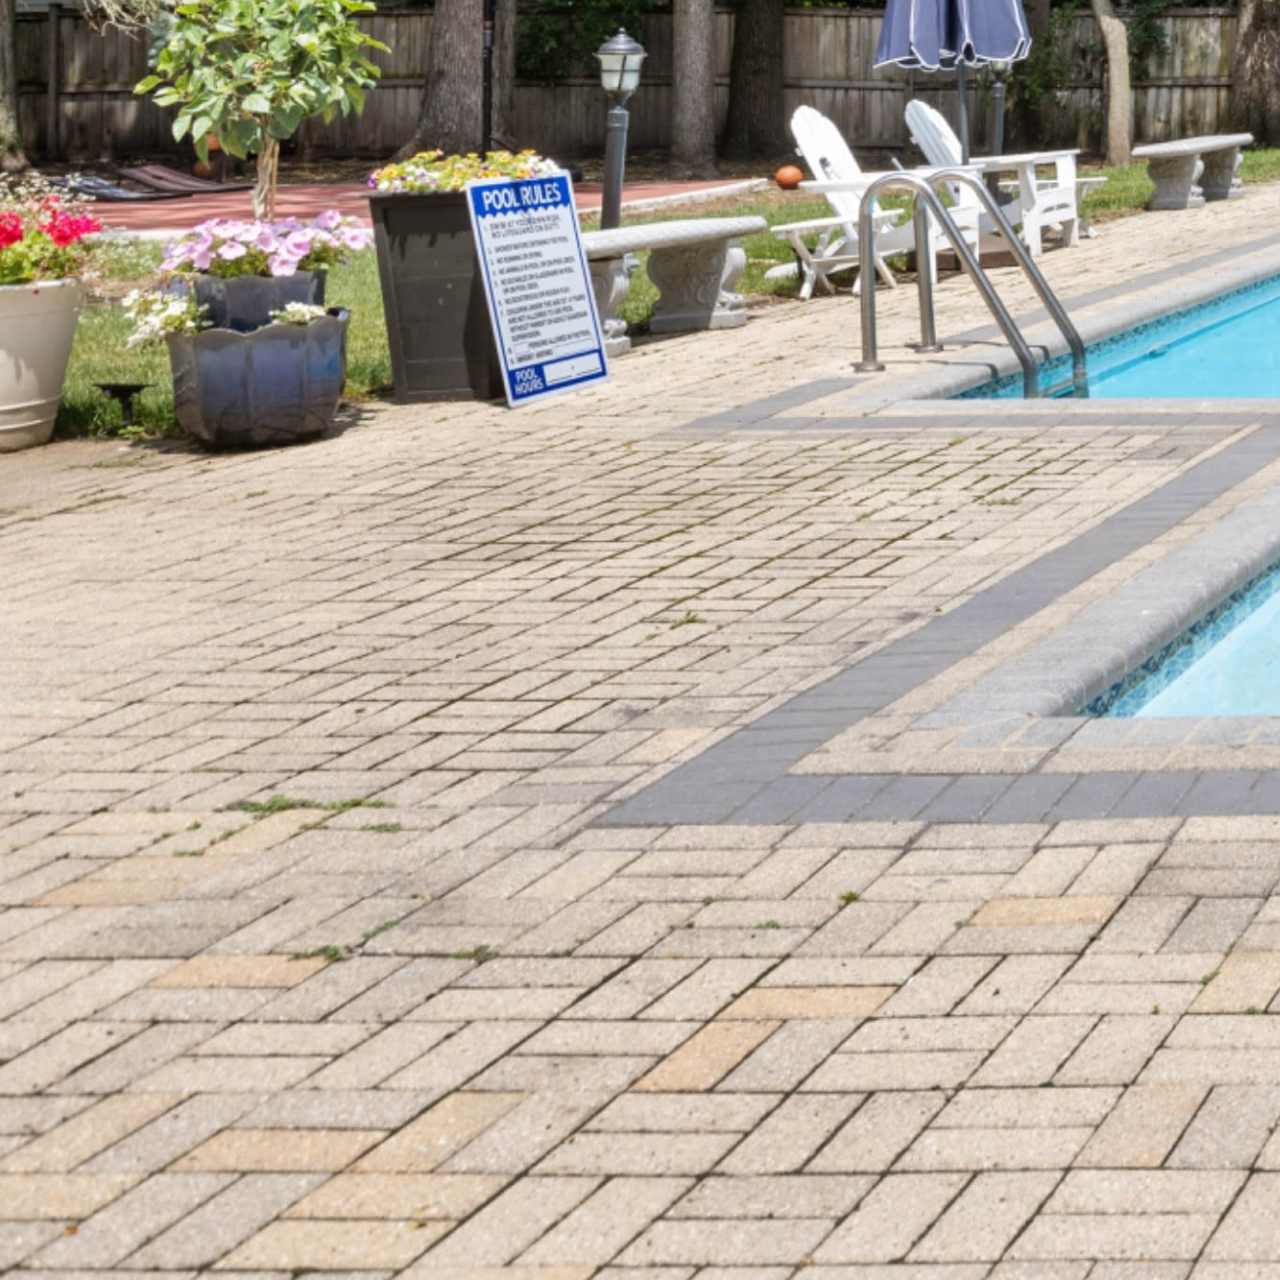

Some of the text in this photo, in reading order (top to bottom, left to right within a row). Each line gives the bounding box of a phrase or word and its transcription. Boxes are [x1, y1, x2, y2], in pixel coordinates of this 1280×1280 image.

[483, 183, 561, 211] POOL RULES
[514, 367, 537, 383] POOL
[514, 377, 544, 394] HOURS
